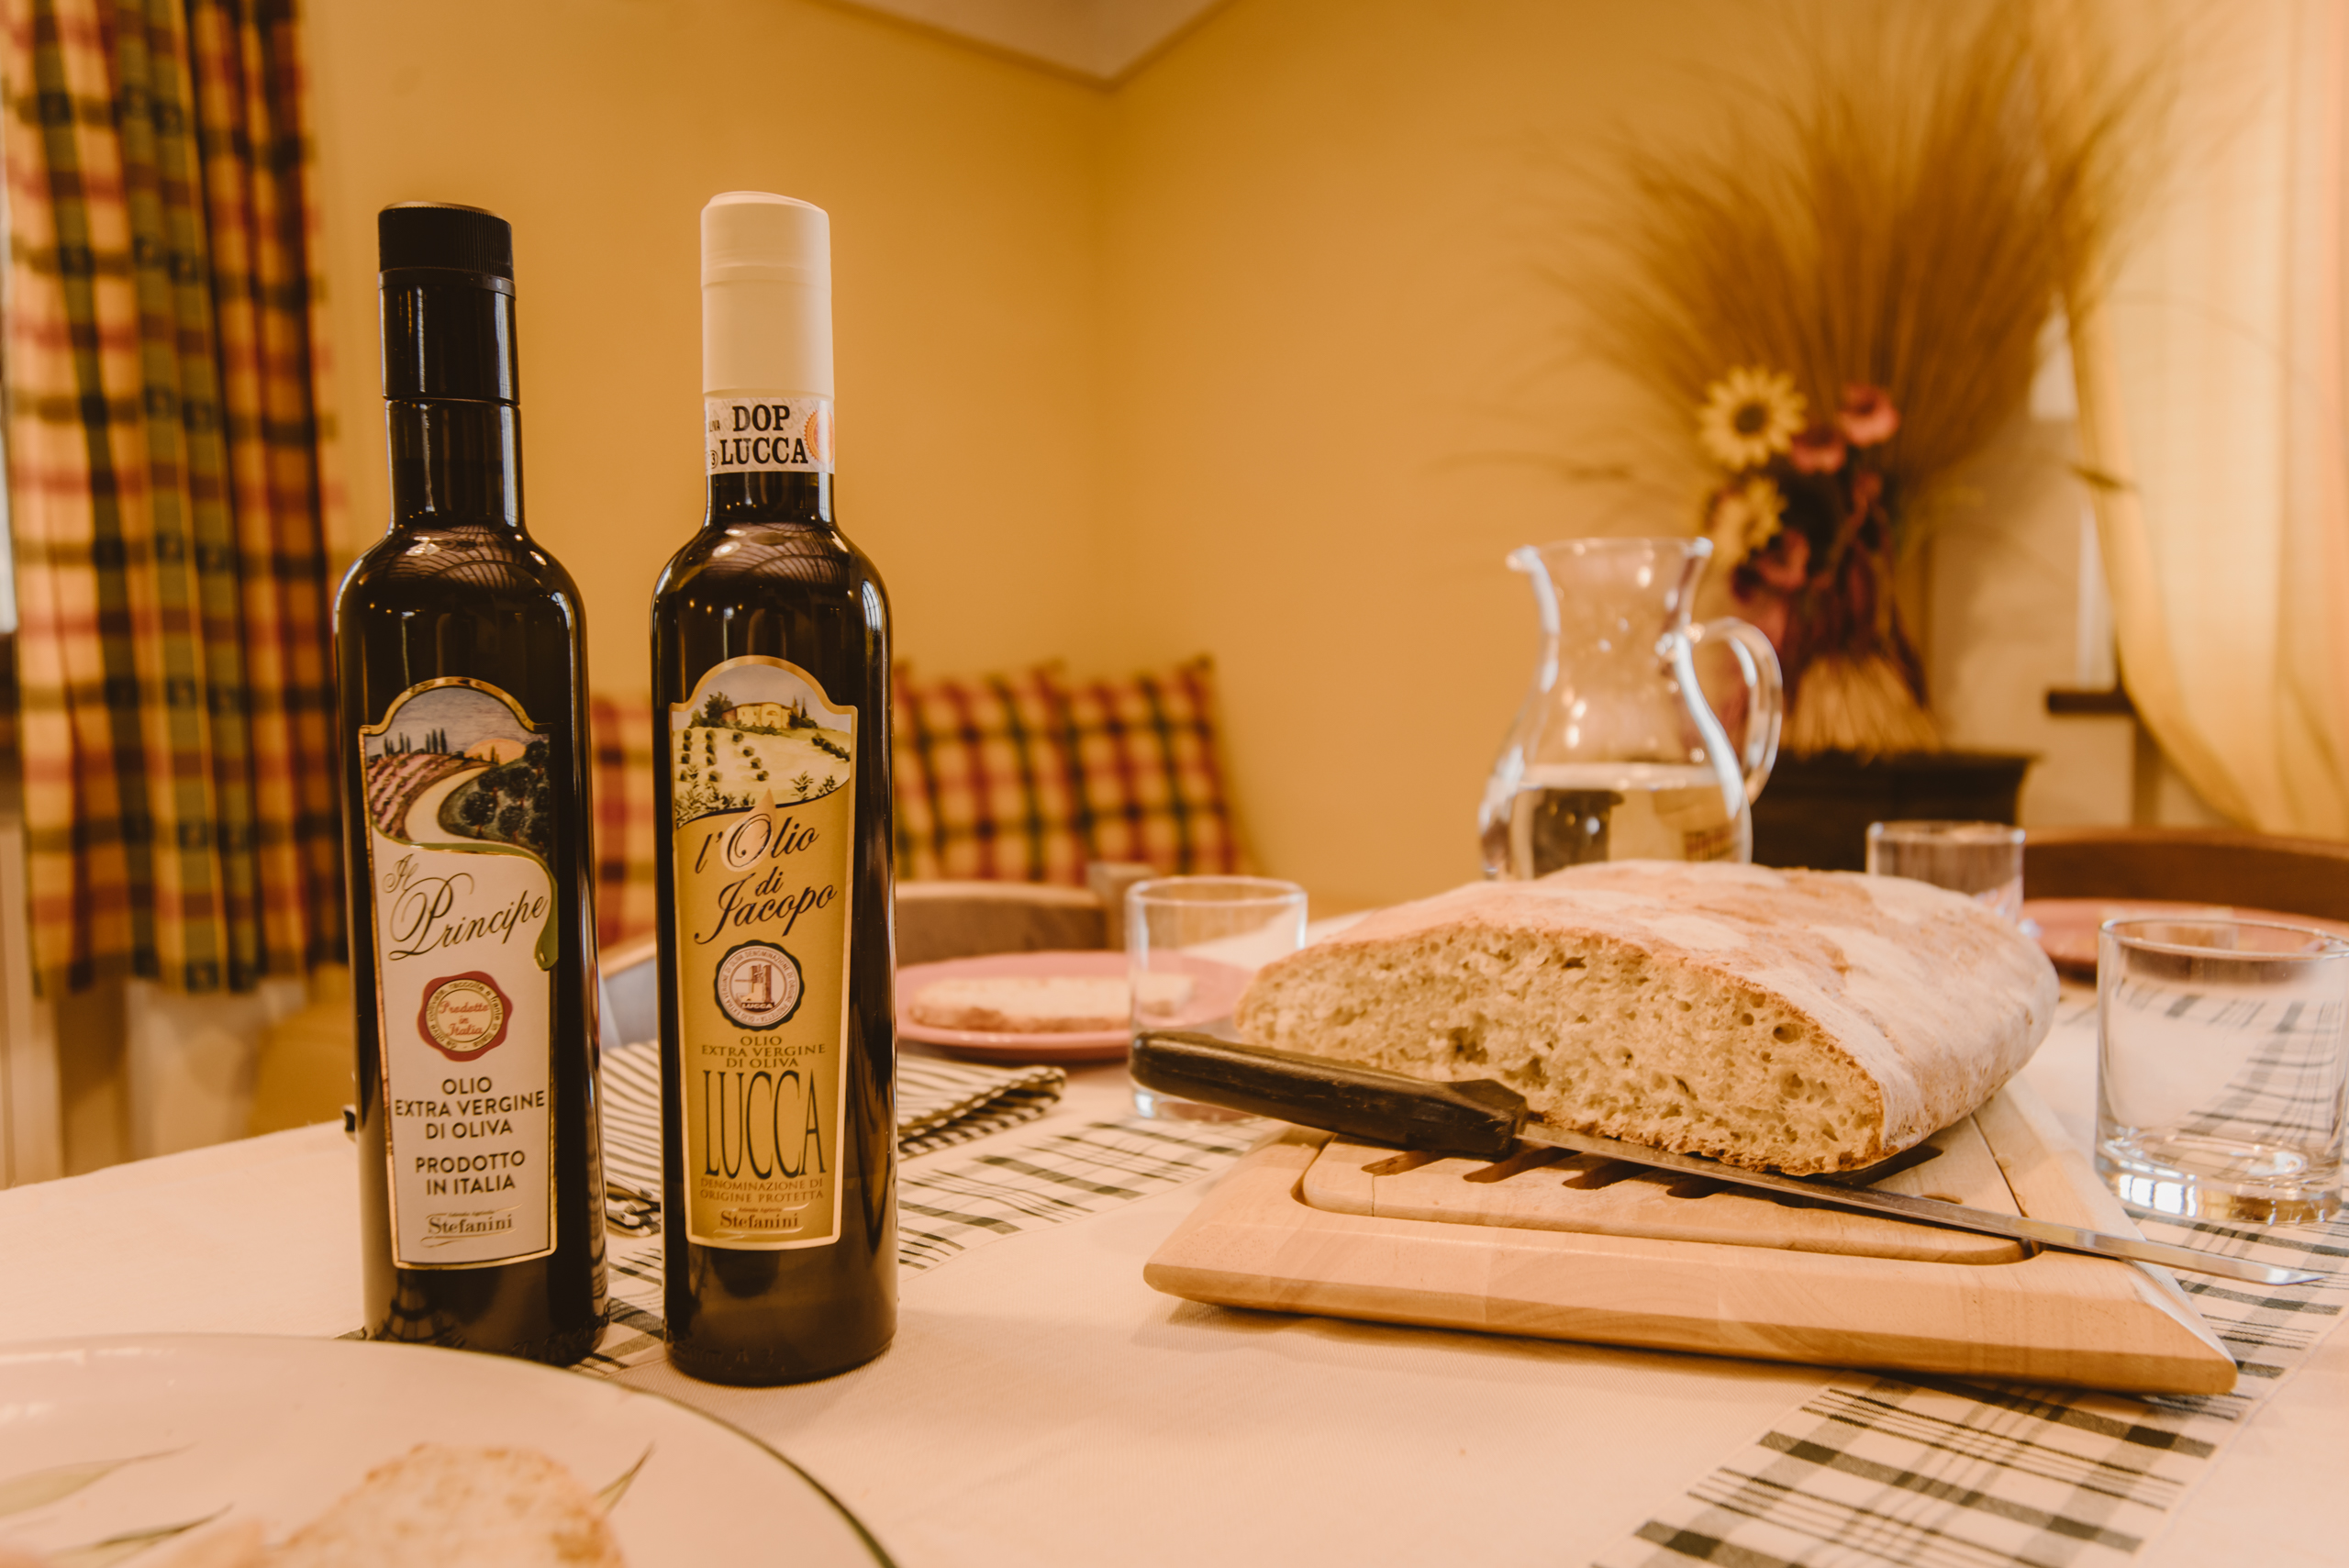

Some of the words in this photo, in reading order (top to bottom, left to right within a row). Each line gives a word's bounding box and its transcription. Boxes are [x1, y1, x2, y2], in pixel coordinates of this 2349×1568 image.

[732, 405, 790, 431] DOP
[720, 437, 808, 465] LUCCA
[755, 866, 784, 896] di
[388, 873, 549, 961] Principe
[694, 873, 838, 945] Jacopo
[447, 1023, 484, 1037] Italia
[740, 1036, 782, 1046] OLIO
[702, 1044, 748, 1057] EXTRA
[752, 1043, 826, 1057] VERGINE
[726, 1058, 743, 1068] DI
[749, 1058, 798, 1068] OLIVA
[442, 1076, 492, 1095] OLIO
[395, 1099, 452, 1118] EXTRA
[457, 1090, 545, 1116] VERGINE
[426, 1123, 445, 1140] DI
[452, 1118, 513, 1139] OLIVA
[703, 1069, 827, 1180] LUCCA
[416, 1151, 525, 1173] PRODOTTO
[427, 1179, 446, 1195] IN
[454, 1173, 516, 1195] ITALIA
[700, 1177, 806, 1192] DENOMINAZIONE
[809, 1178, 823, 1188] DI
[699, 1188, 751, 1203] ORIGINE
[758, 1190, 825, 1203] PROTETTA
[428, 1214, 513, 1234] Stefanini
[720, 1210, 799, 1229] Stefanini
